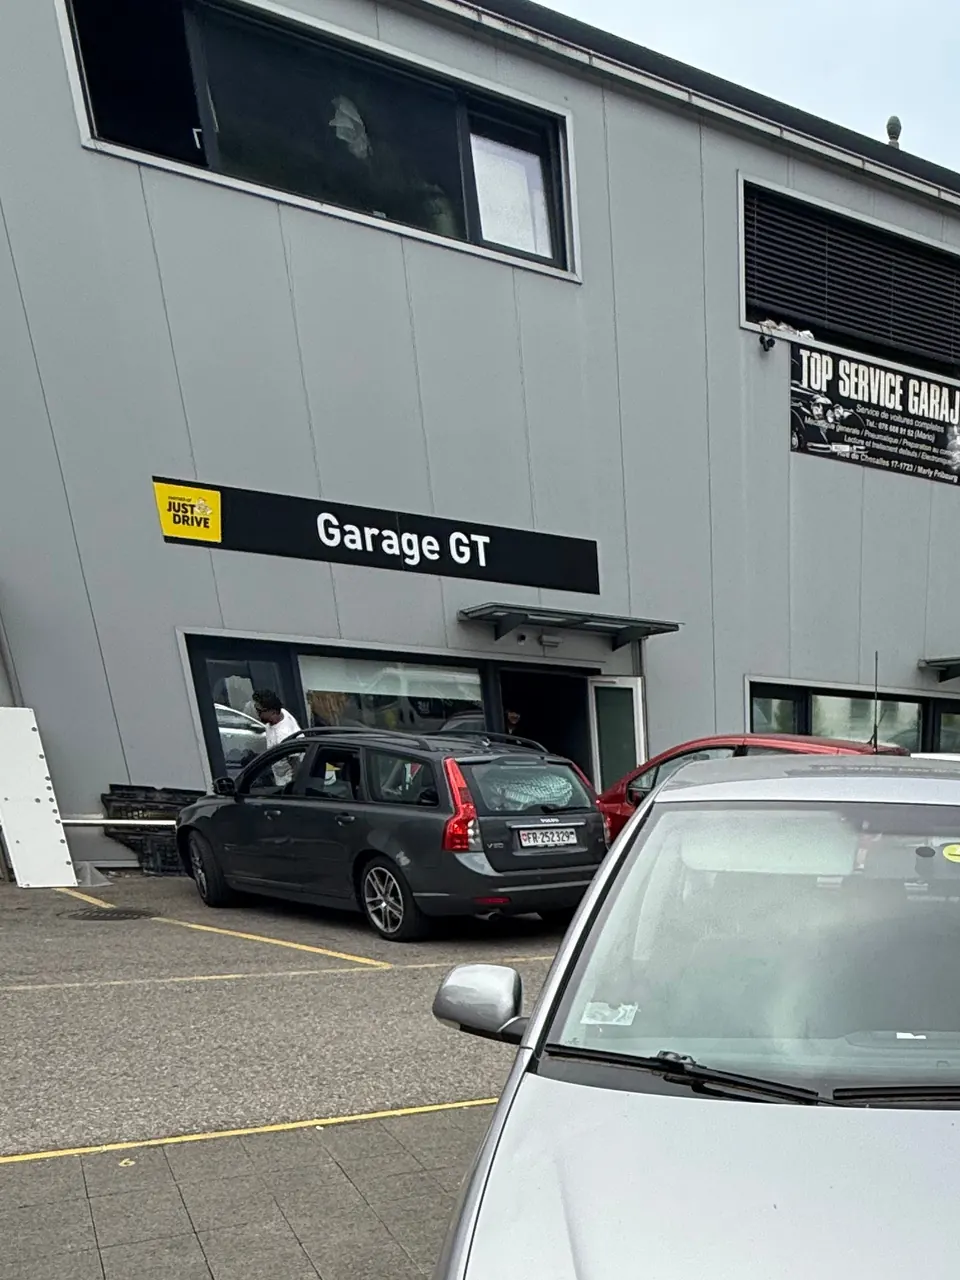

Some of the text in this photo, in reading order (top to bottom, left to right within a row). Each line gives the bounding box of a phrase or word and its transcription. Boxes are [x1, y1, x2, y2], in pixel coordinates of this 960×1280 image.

[800, 349, 833, 392] TOP
[838, 359, 904, 411] SERVICE
[856, 403, 880, 417] Service
[880, 411, 889, 420] de
[167, 500, 196, 515] JUST
[172, 513, 210, 529] DRIVE
[316, 512, 491, 567] Garage GT
